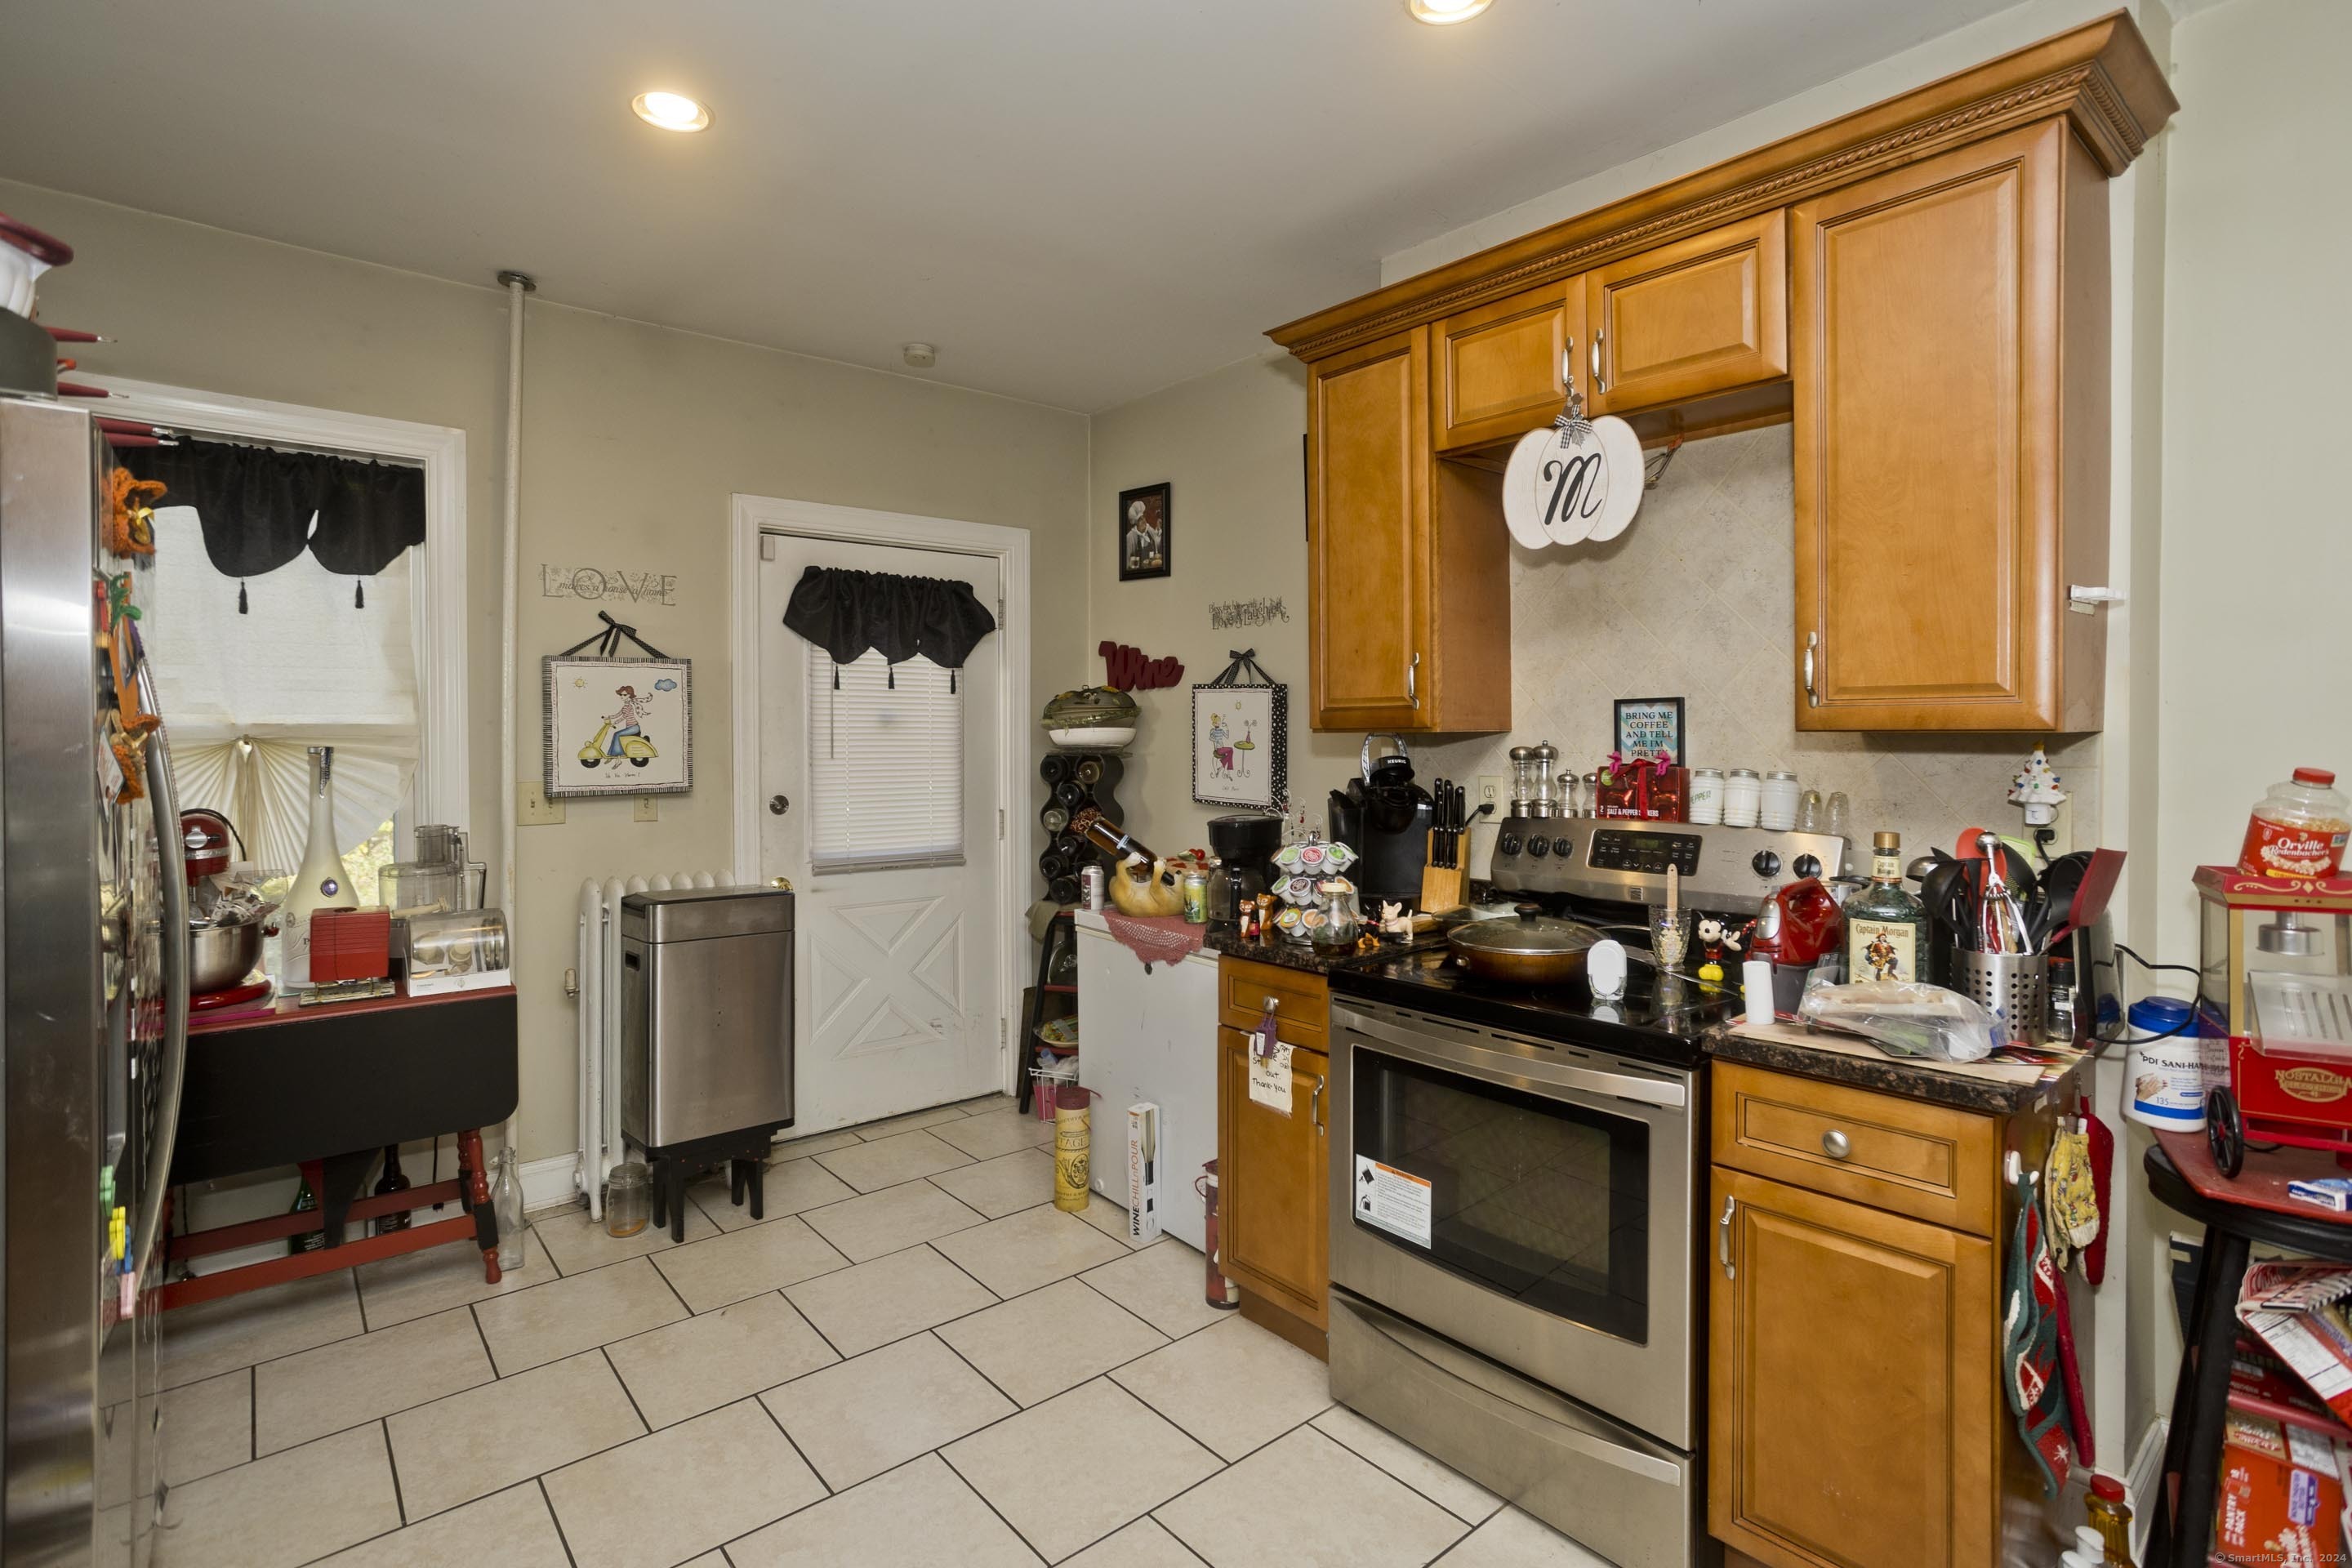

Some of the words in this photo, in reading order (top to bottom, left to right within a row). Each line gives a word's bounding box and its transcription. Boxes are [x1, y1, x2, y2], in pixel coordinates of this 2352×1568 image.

[541, 564, 677, 606] LOVE
[1098, 641, 1185, 693] Wine
[1649, 730, 1673, 738] TELL
[1690, 791, 1712, 804] EPPER
[2278, 837, 2324, 850] Orville
[1855, 924, 1880, 936] Captain
[1882, 924, 1909, 938] Morgan
[2142, 1056, 2158, 1065] PDI
[2156, 1096, 2169, 1106] 135
[2225, 1493, 2237, 1530] PANTRY
[2234, 1509, 2246, 1535] PACK
